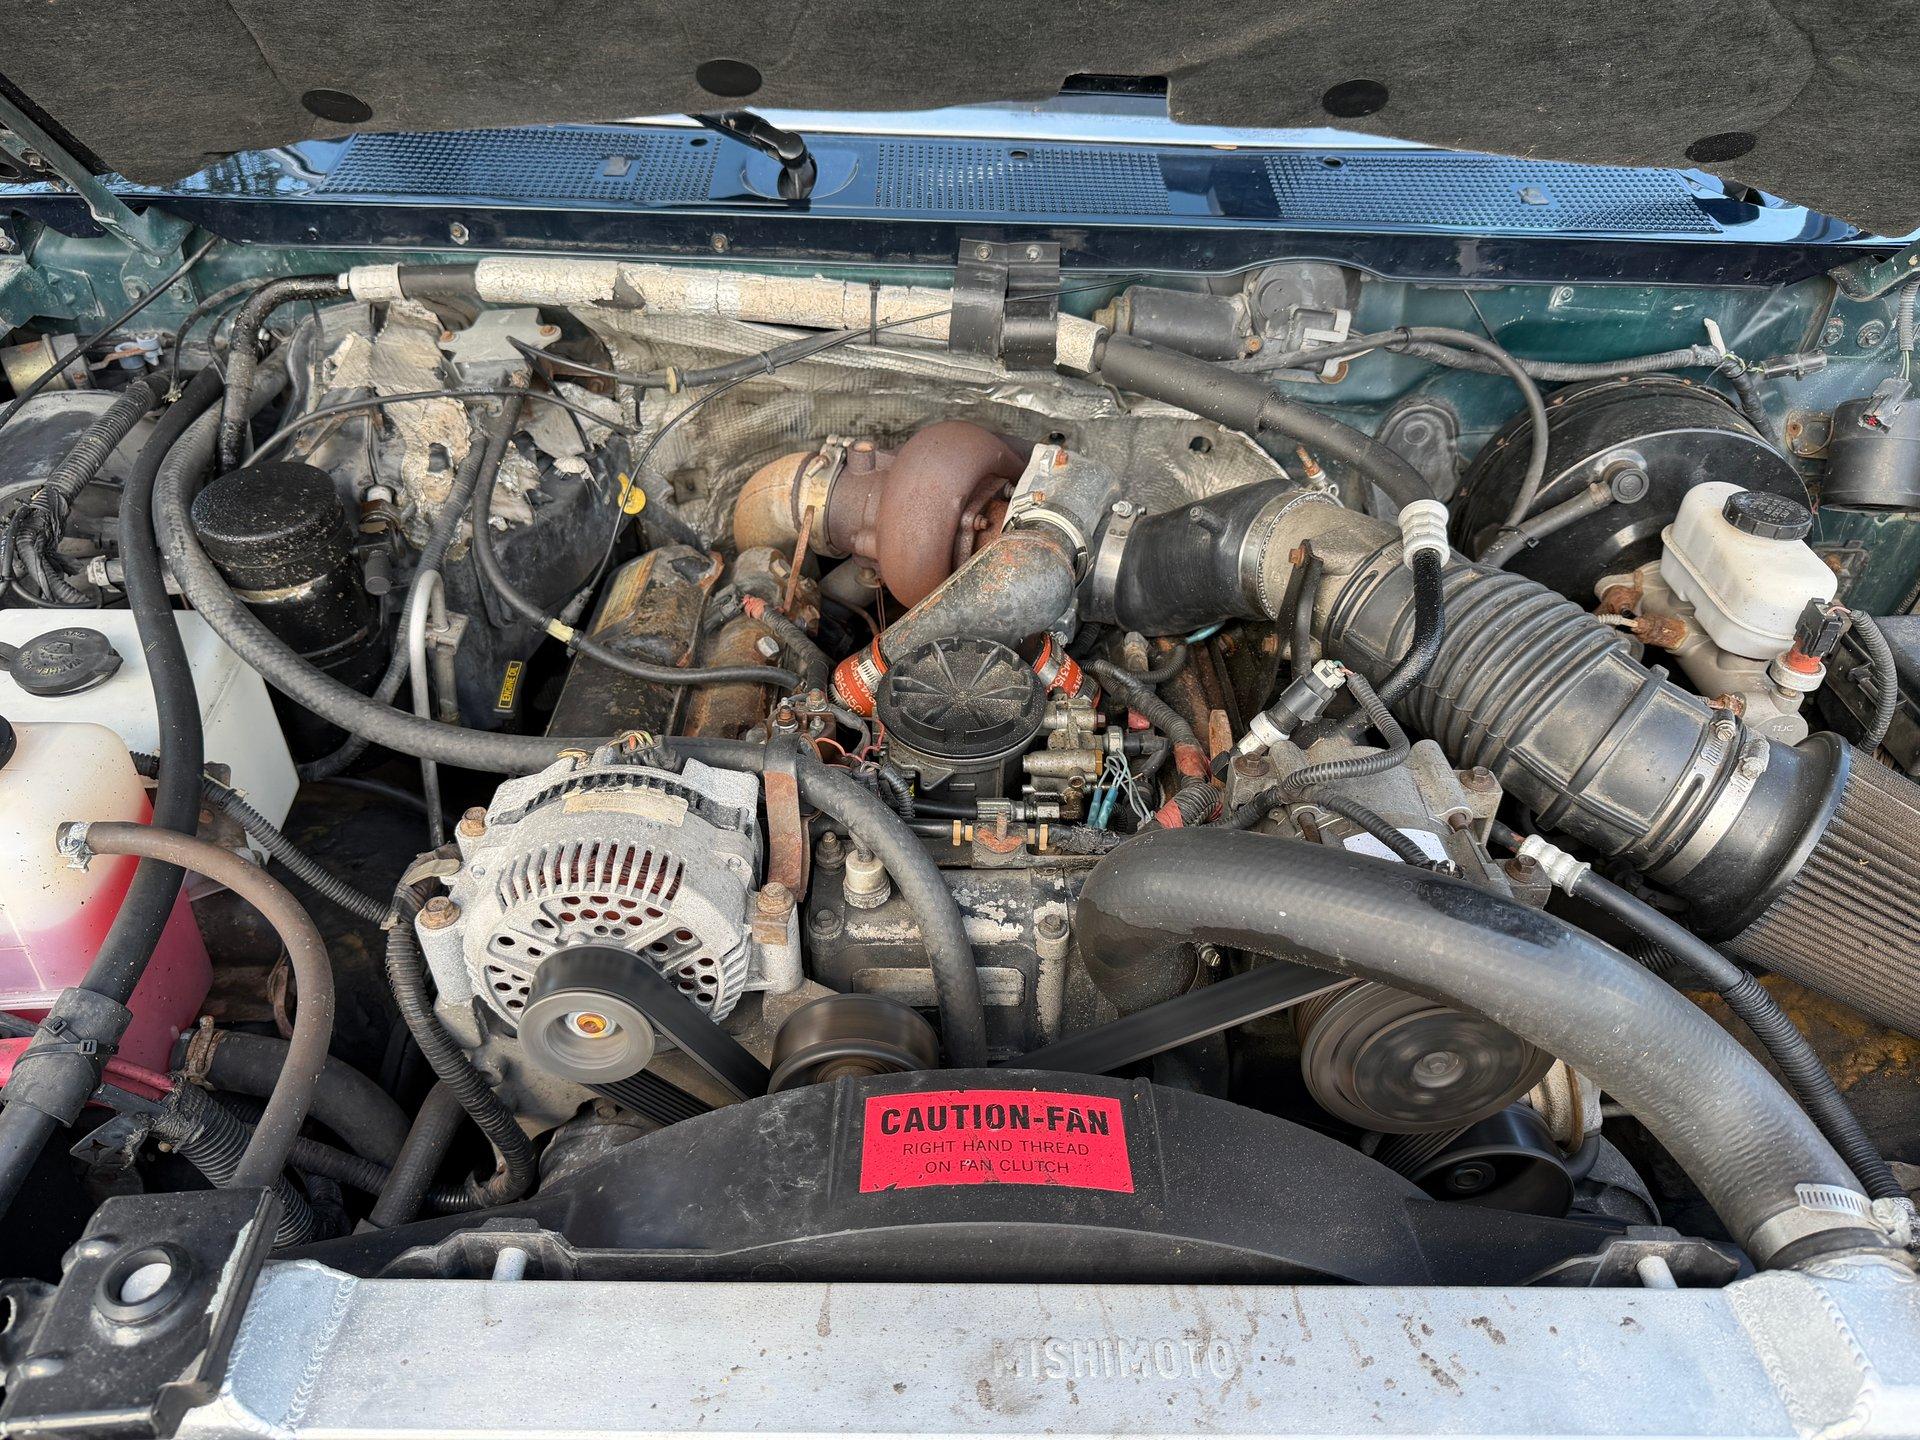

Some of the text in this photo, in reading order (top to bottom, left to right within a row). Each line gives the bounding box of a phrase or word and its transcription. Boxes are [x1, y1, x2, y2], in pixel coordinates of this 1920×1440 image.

[502, 667, 519, 701] ENGINE OIL
[881, 1104, 1110, 1136] CAUTION-FAN
[903, 1140, 1090, 1156] RIGHT HAND THREAD
[925, 1160, 1070, 1174] ON FAN CLUTCH
[993, 1338, 1236, 1379] MISHIMOTO
